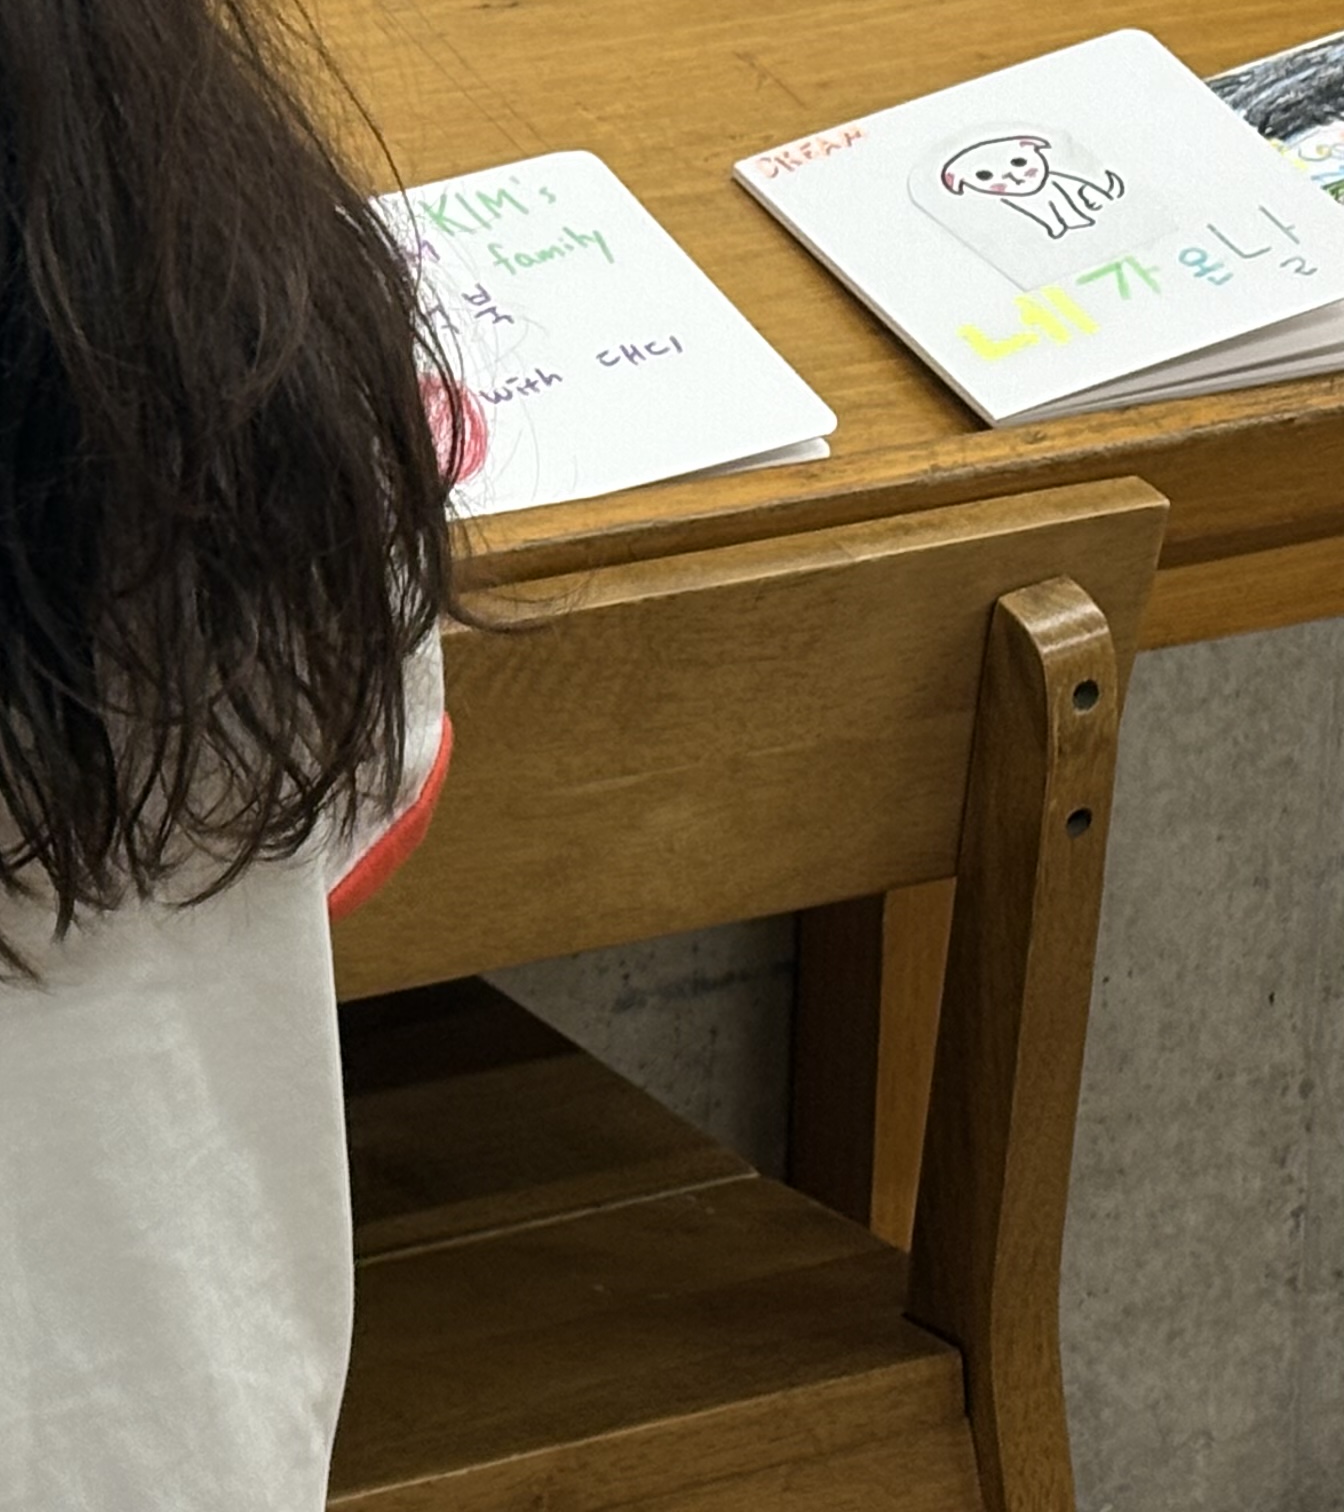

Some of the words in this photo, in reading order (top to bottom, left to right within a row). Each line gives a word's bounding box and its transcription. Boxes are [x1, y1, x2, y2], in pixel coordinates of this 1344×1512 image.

[418, 174, 557, 236] KIM's
[492, 226, 615, 275] family
[1206, 204, 1318, 278] 날
[480, 368, 563, 405] with
